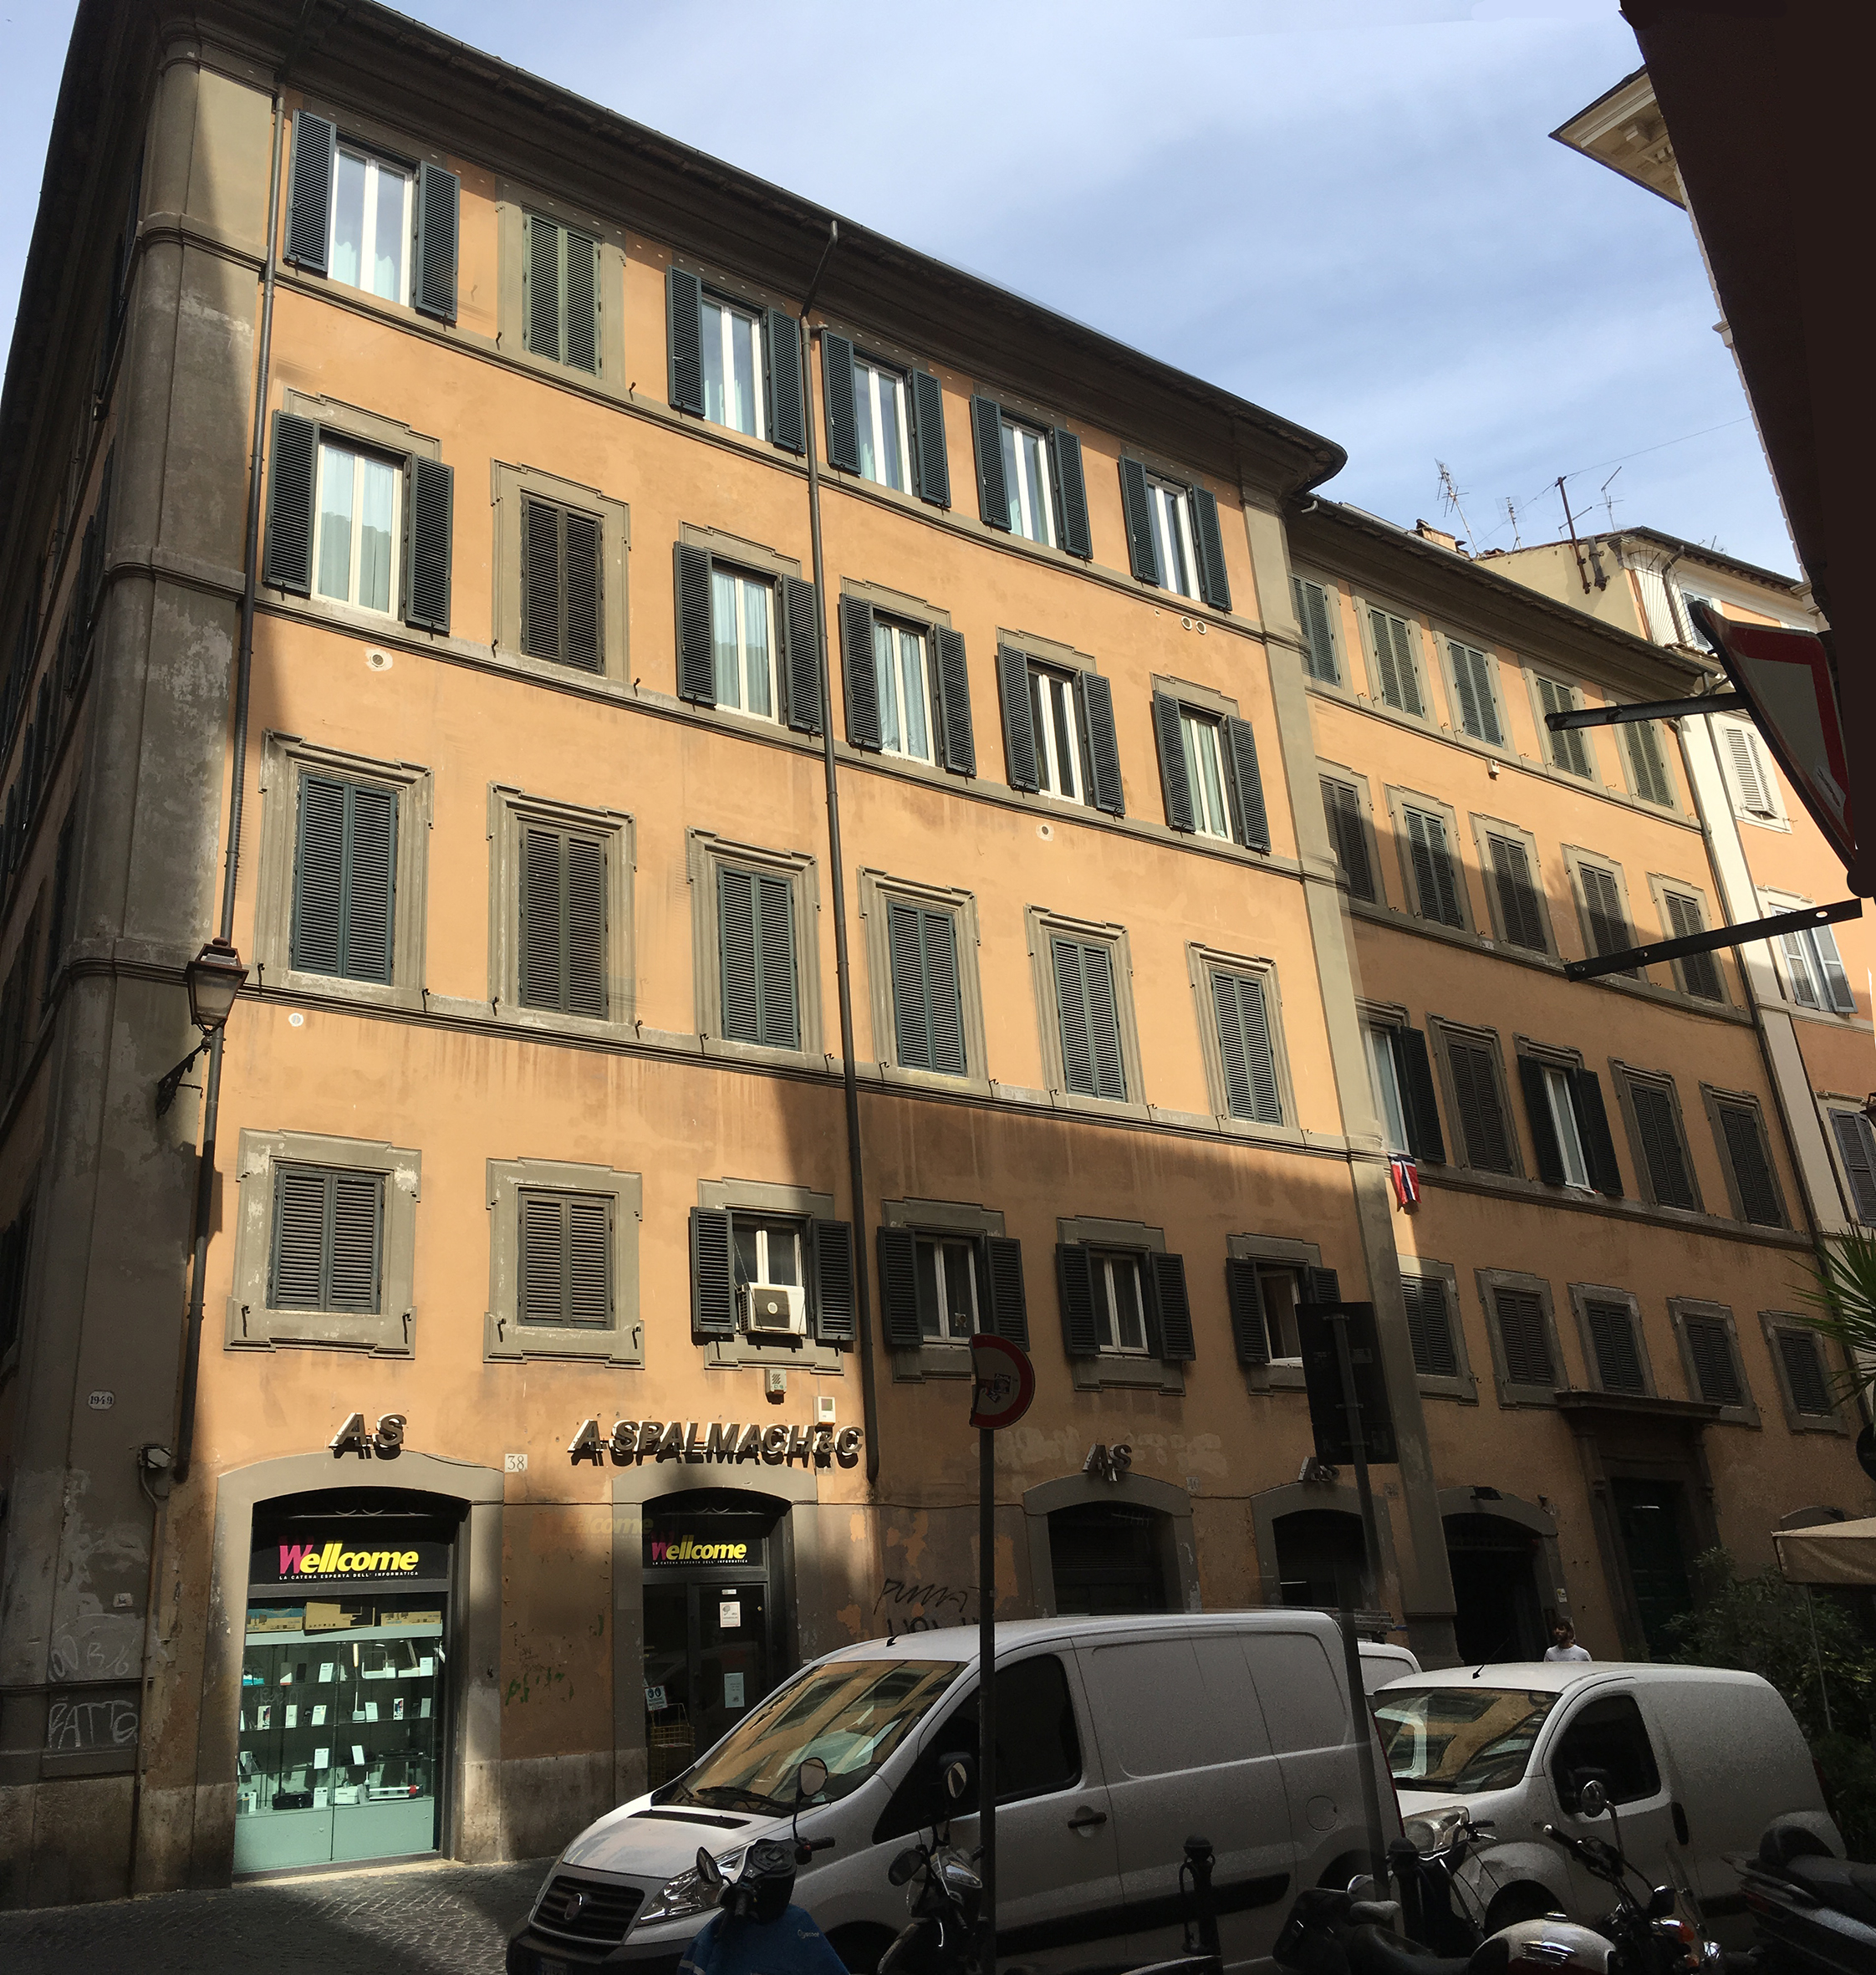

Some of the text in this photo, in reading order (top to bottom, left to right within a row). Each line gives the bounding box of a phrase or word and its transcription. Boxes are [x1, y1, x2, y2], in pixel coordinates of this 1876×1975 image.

[507, 1455, 525, 1471] 38
[278, 1538, 419, 1574] Wellcome
[651, 1534, 747, 1561] Wellcome
